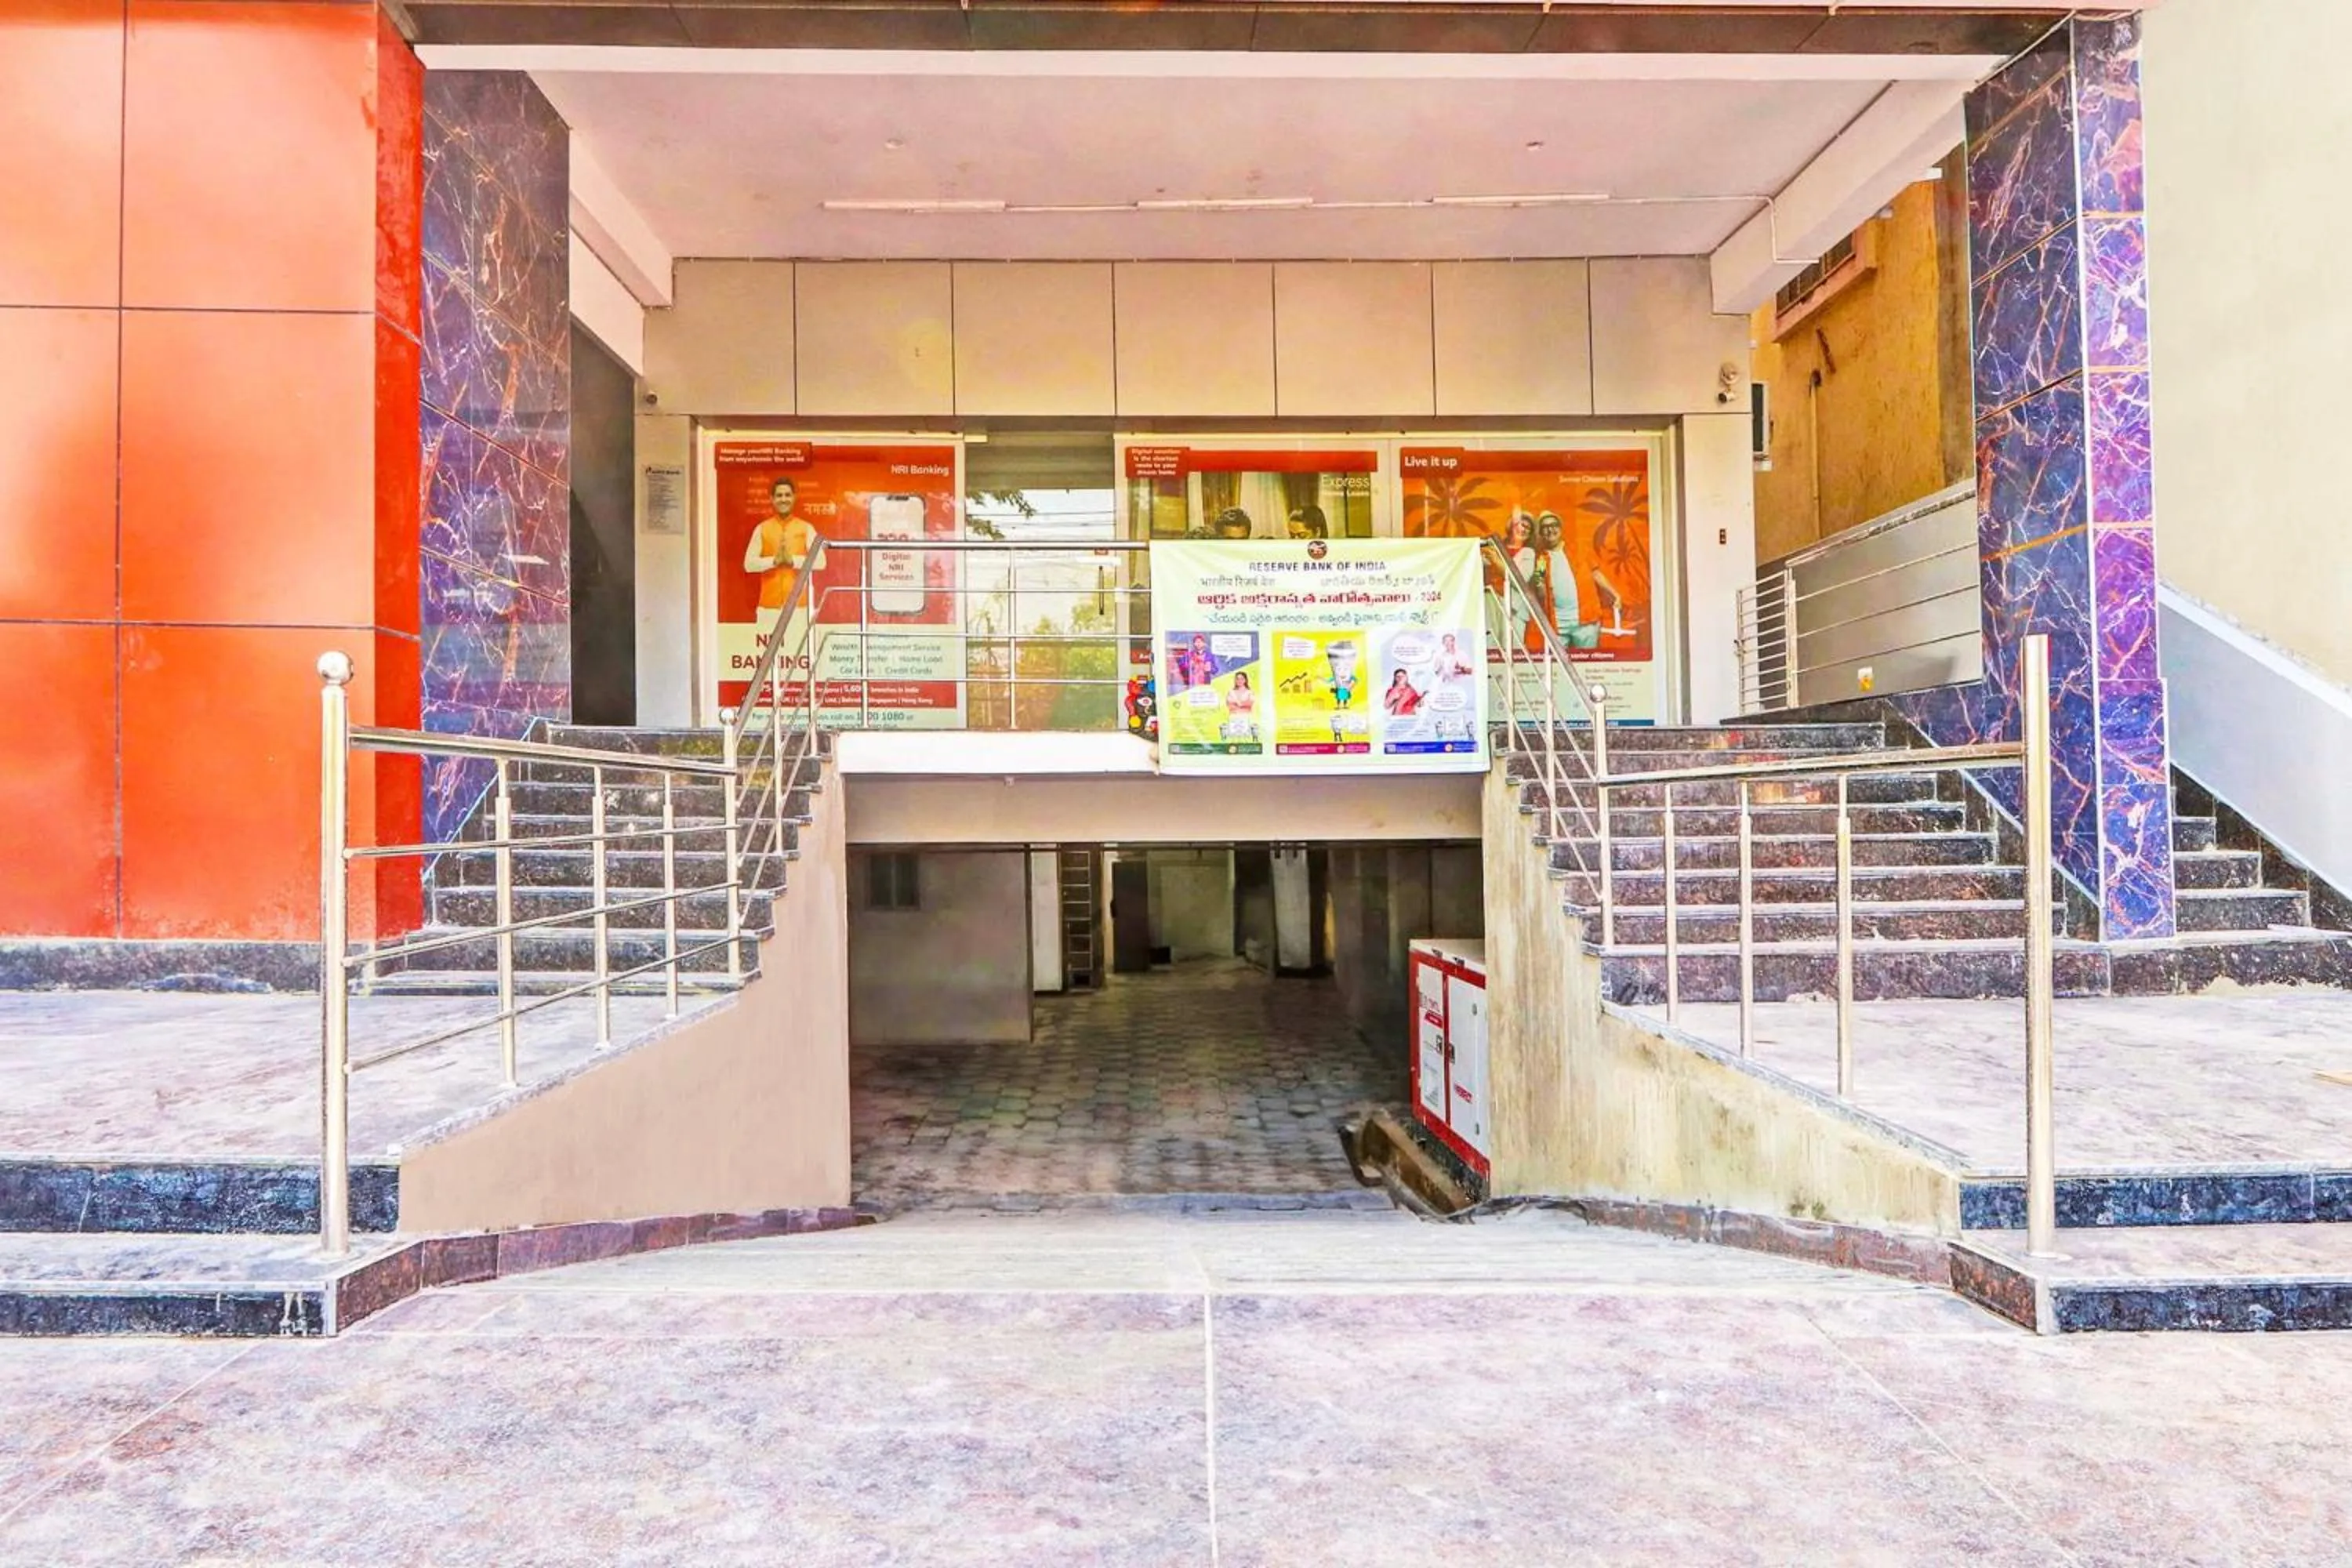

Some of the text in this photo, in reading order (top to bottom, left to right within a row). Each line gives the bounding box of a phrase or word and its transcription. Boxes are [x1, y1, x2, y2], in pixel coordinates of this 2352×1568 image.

[1404, 456, 1457, 469] Live it up
[891, 465, 949, 477] NRI Banking
[1321, 475, 1370, 488] Express
[882, 552, 911, 561] Digital
[1249, 561, 1386, 572] RESERVE BANK OF INDIA
[879, 572, 914, 581] Services
[1421, 590, 1442, 602] 2024
[756, 633, 785, 648] NI
[731, 655, 810, 669] BAING
[857, 712, 879, 720] 100
[881, 712, 905, 720] 1080
